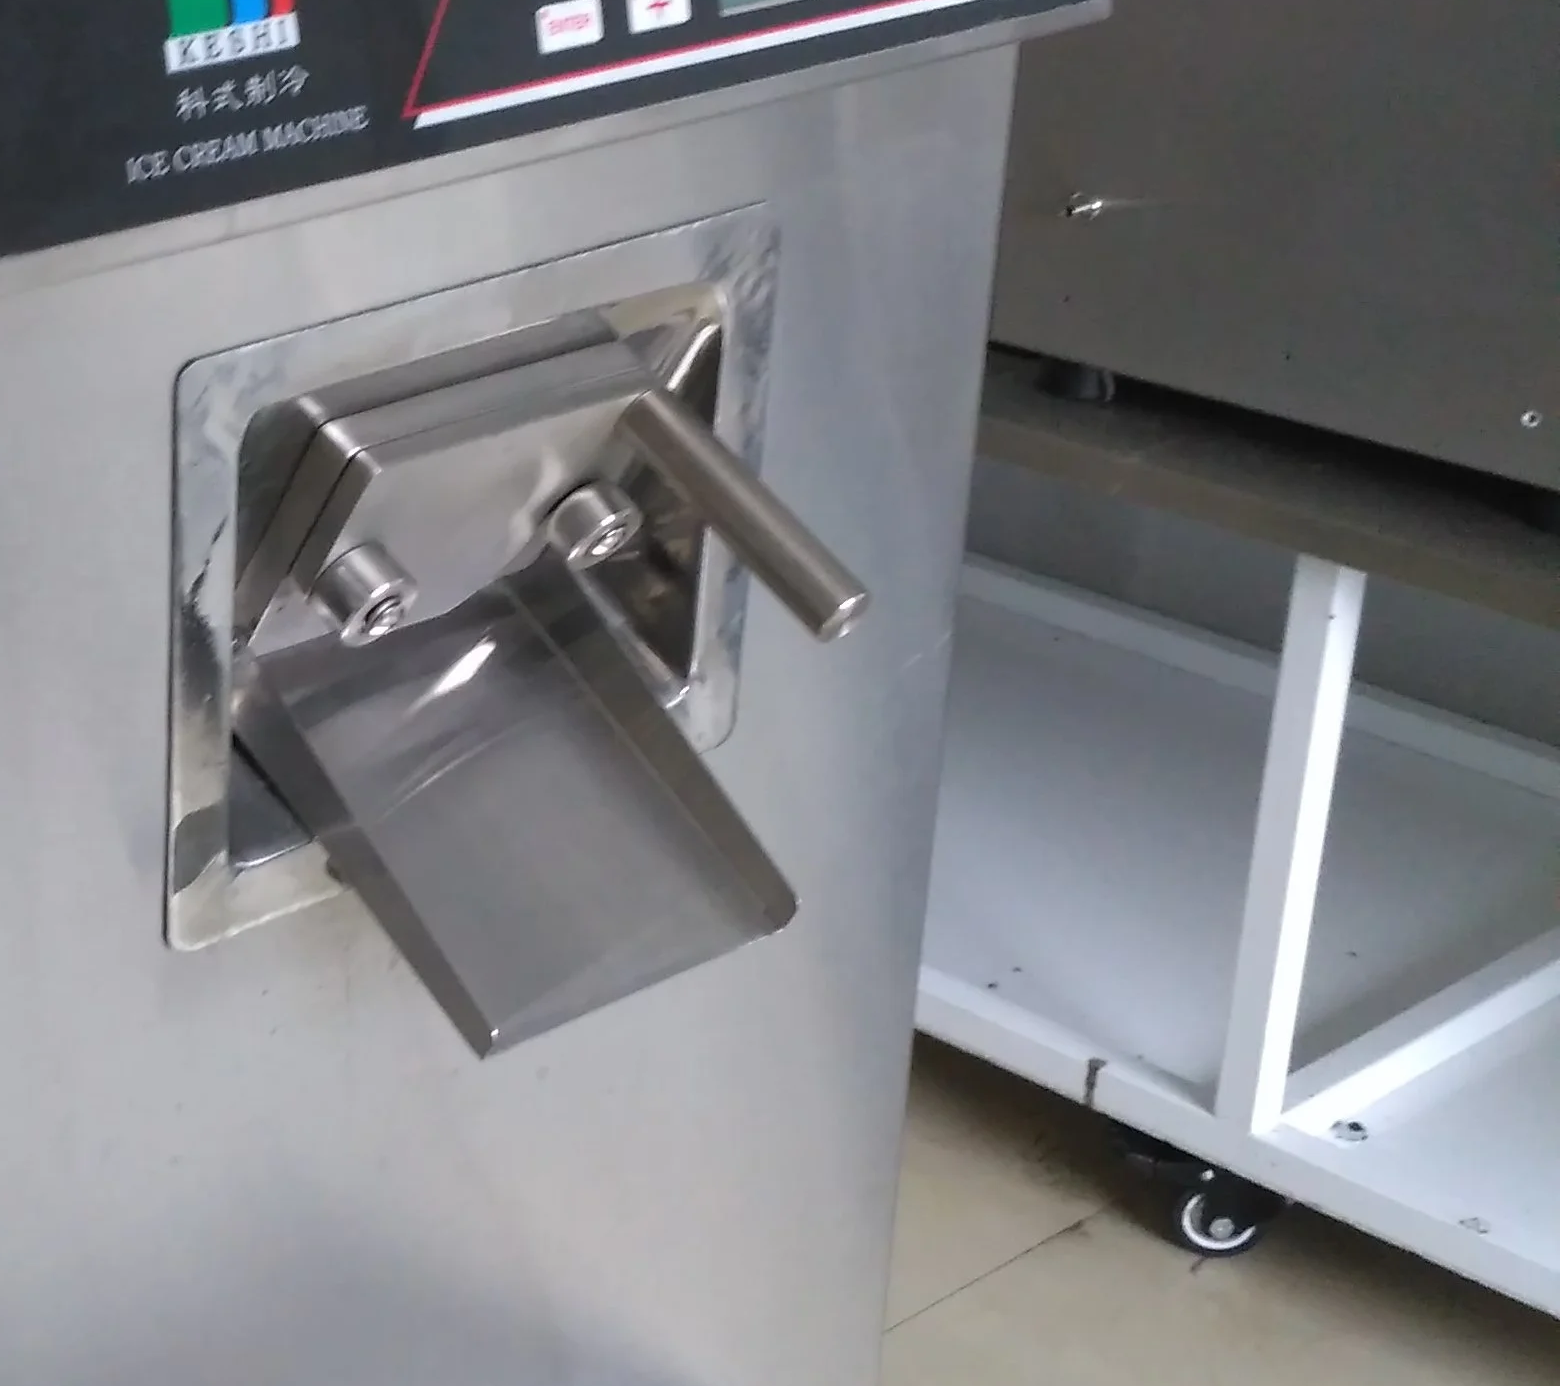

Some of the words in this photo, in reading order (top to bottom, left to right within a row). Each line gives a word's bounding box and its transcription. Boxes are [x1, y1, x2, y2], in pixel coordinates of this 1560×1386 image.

[178, 19, 288, 65] KESHI
[176, 65, 309, 122] 科式制冷
[126, 149, 170, 184] ICE
[172, 129, 258, 173] CREAM
[263, 105, 370, 153] MACHINE
